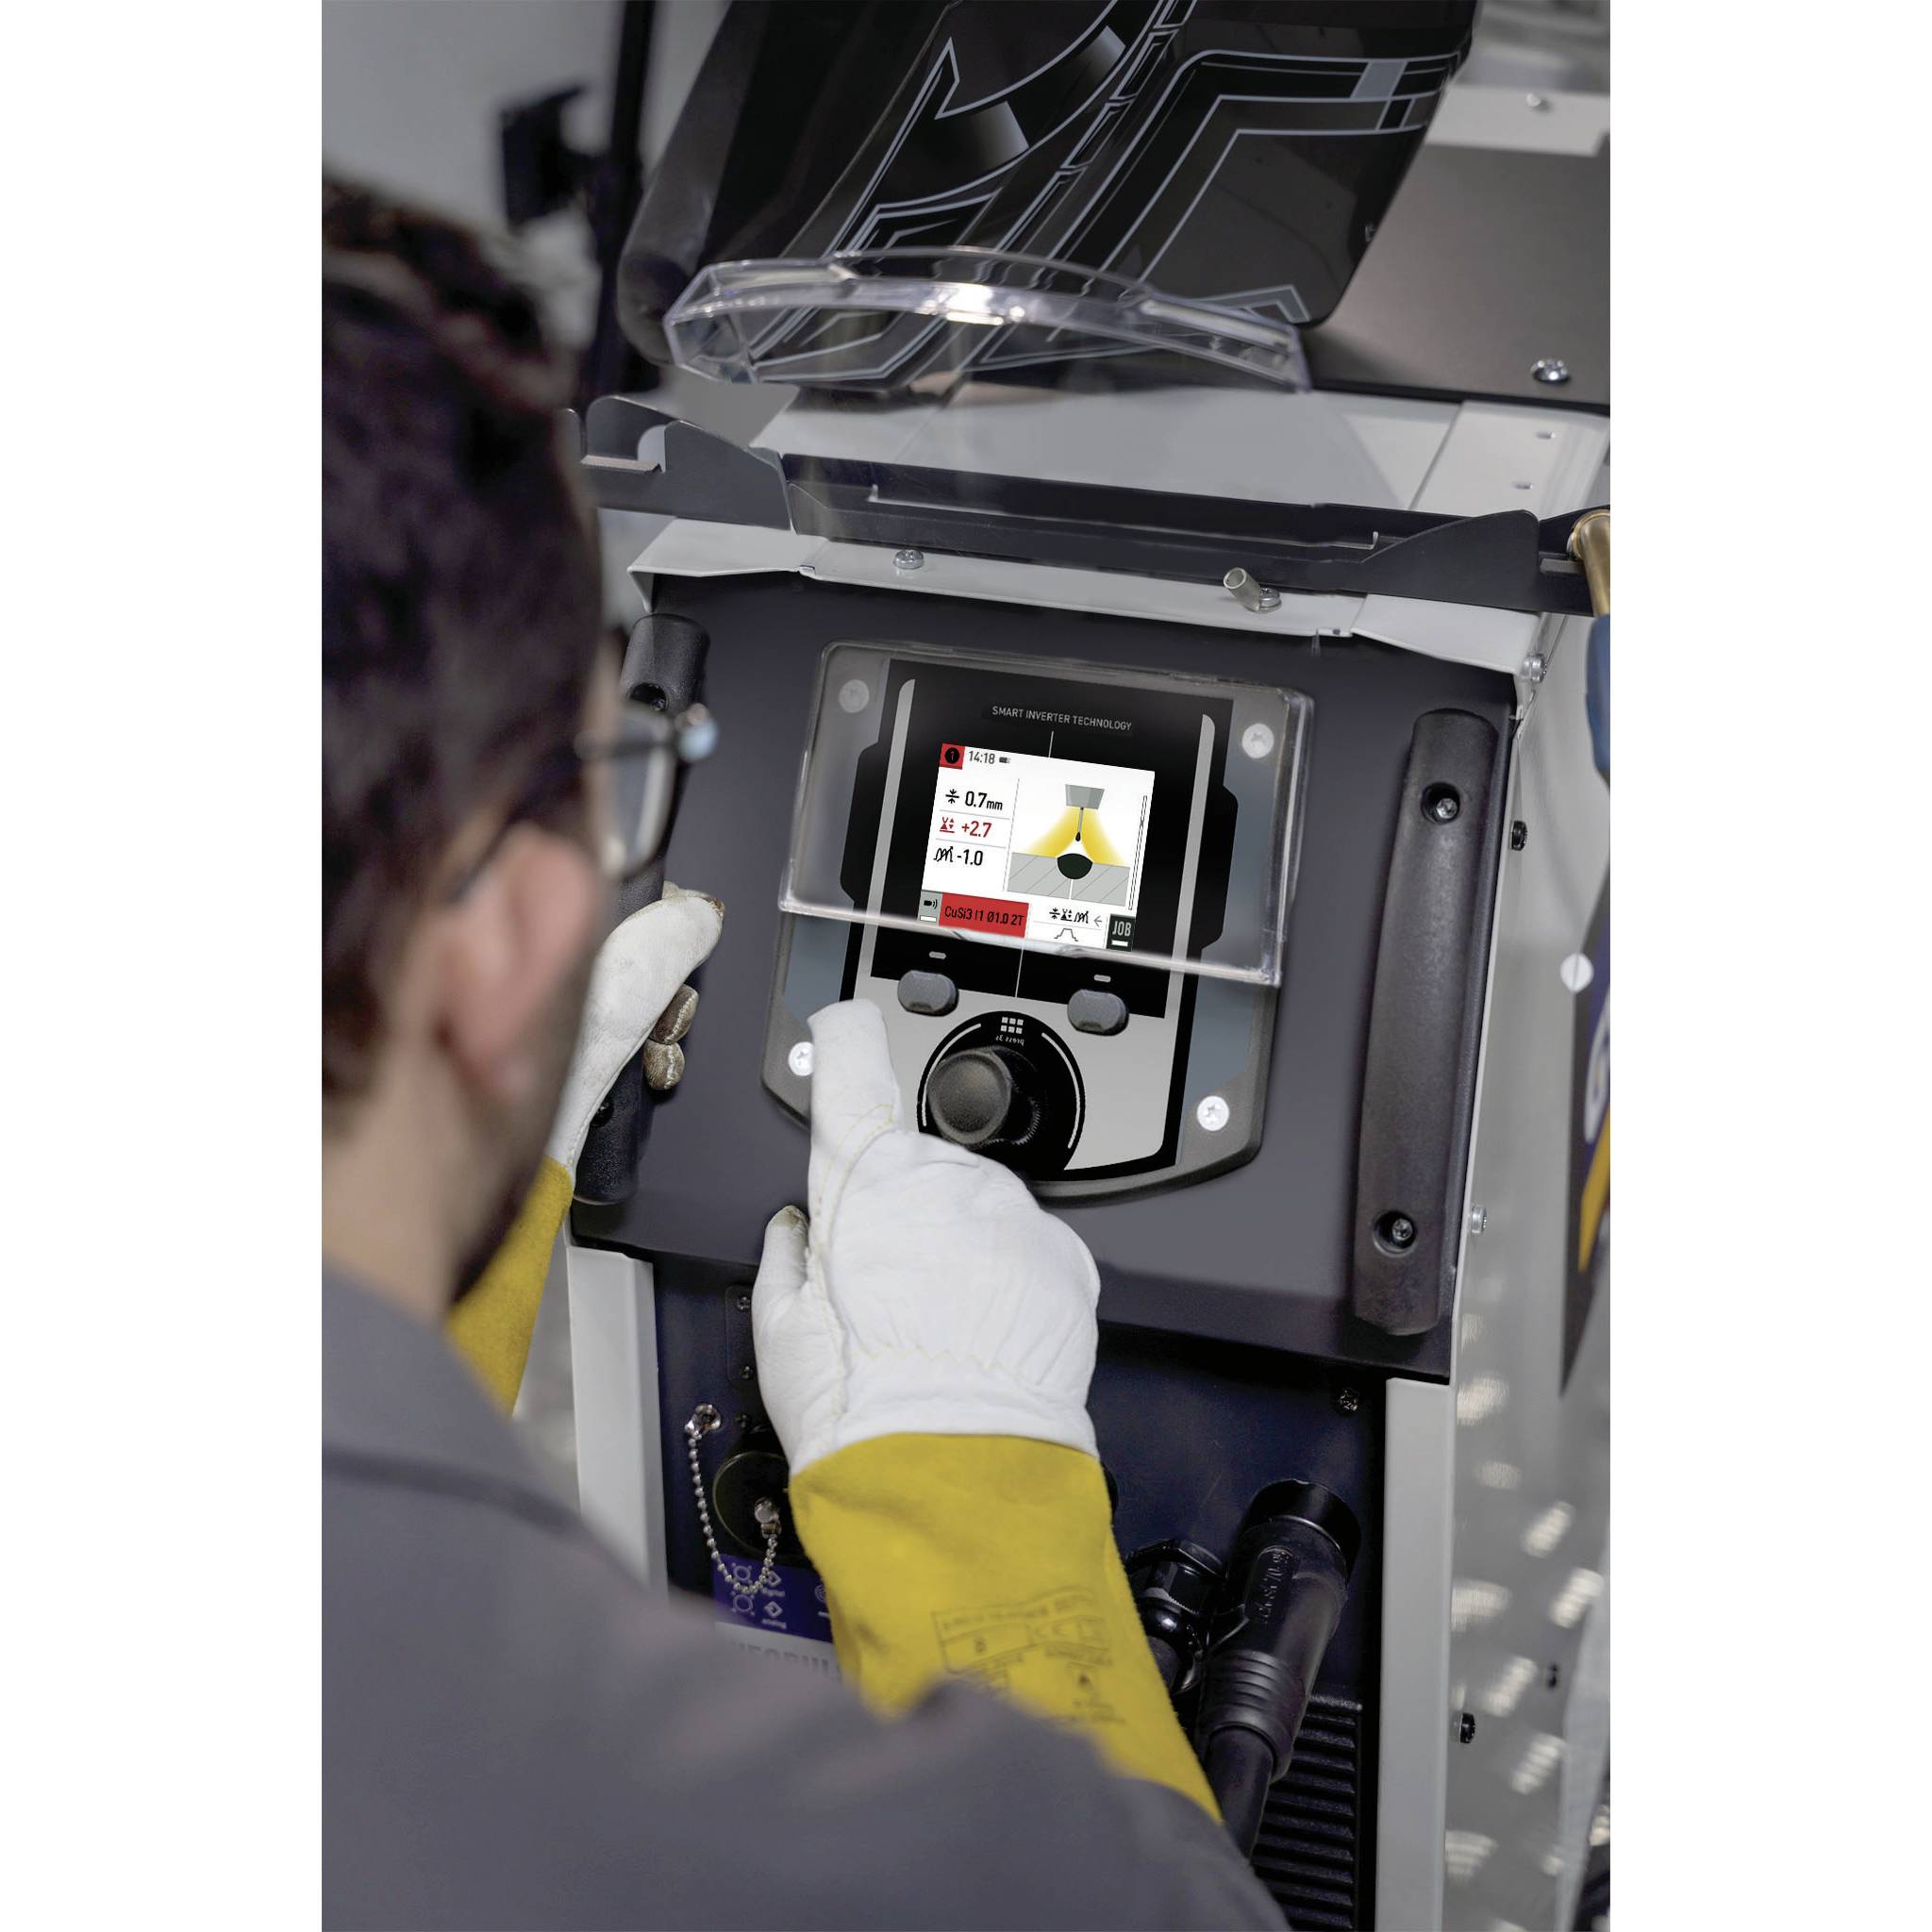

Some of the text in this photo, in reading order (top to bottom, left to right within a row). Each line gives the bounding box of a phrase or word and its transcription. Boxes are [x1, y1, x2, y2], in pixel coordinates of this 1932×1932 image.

[992, 706, 1132, 731] SMART INVERTER TECHNOLOGY
[968, 750, 995, 764] 14:18
[961, 820, 992, 838] +2.7
[957, 849, 984, 866] -1.0
[944, 906, 973, 920] CuSi3
[1010, 914, 1025, 926] 2T
[1112, 920, 1132, 937] JOB
